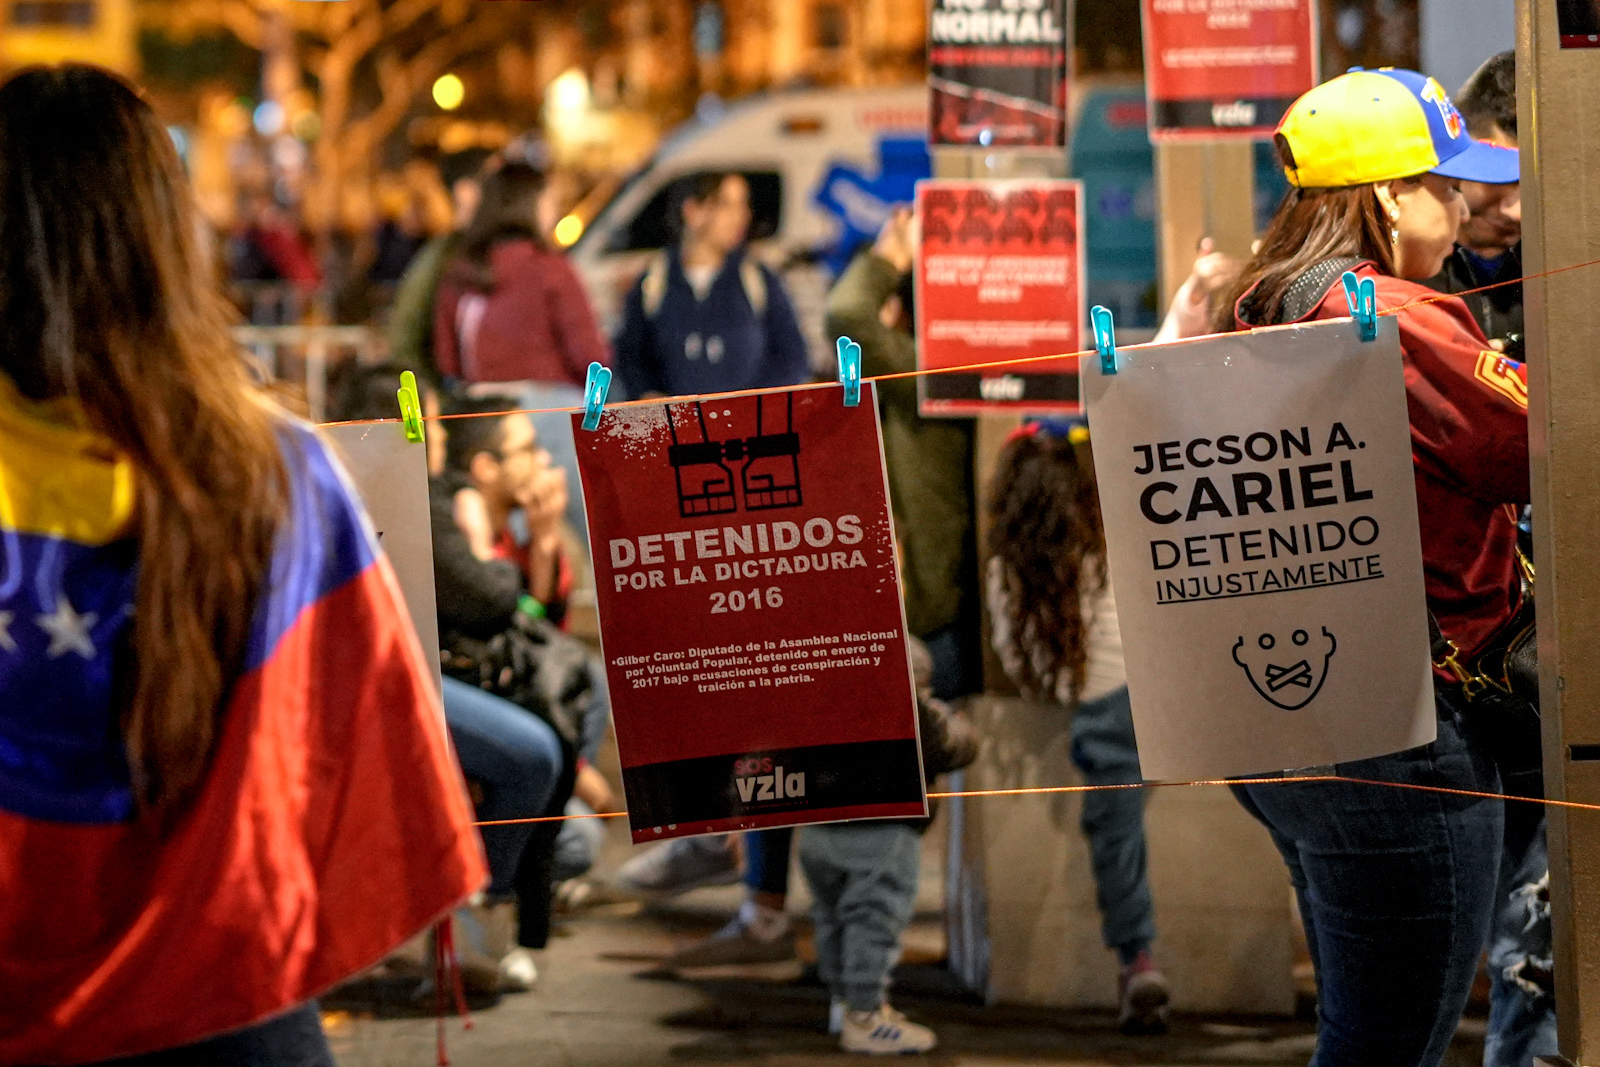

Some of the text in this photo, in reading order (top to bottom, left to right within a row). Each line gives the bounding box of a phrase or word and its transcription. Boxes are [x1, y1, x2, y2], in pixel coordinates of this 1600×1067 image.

[1133, 422, 1366, 475] JECSON A.
[1140, 459, 1373, 525] CARIEL
[609, 514, 864, 569] DETENIDOS
[1150, 515, 1380, 570] DETENIDO
[614, 549, 867, 592] POR LA DICTADURA
[1156, 554, 1383, 603] INJUSTAMENTE
[709, 586, 784, 614] 2016
[625, 642, 885, 680] por Voluntad Popular, detenido en enero de
[653, 650, 685, 662] Caro:
[688, 644, 742, 661] Diputado
[746, 642, 761, 652] de
[764, 640, 776, 650] la
[779, 634, 840, 649] Asamblea
[843, 629, 898, 642] Nacional
[632, 656, 881, 689] 2017 bajo acusaciones de conspiración y
[698, 679, 745, 693] traición
[760, 677, 771, 686] la
[775, 674, 814, 688] patria.
[736, 765, 806, 802] vzla
